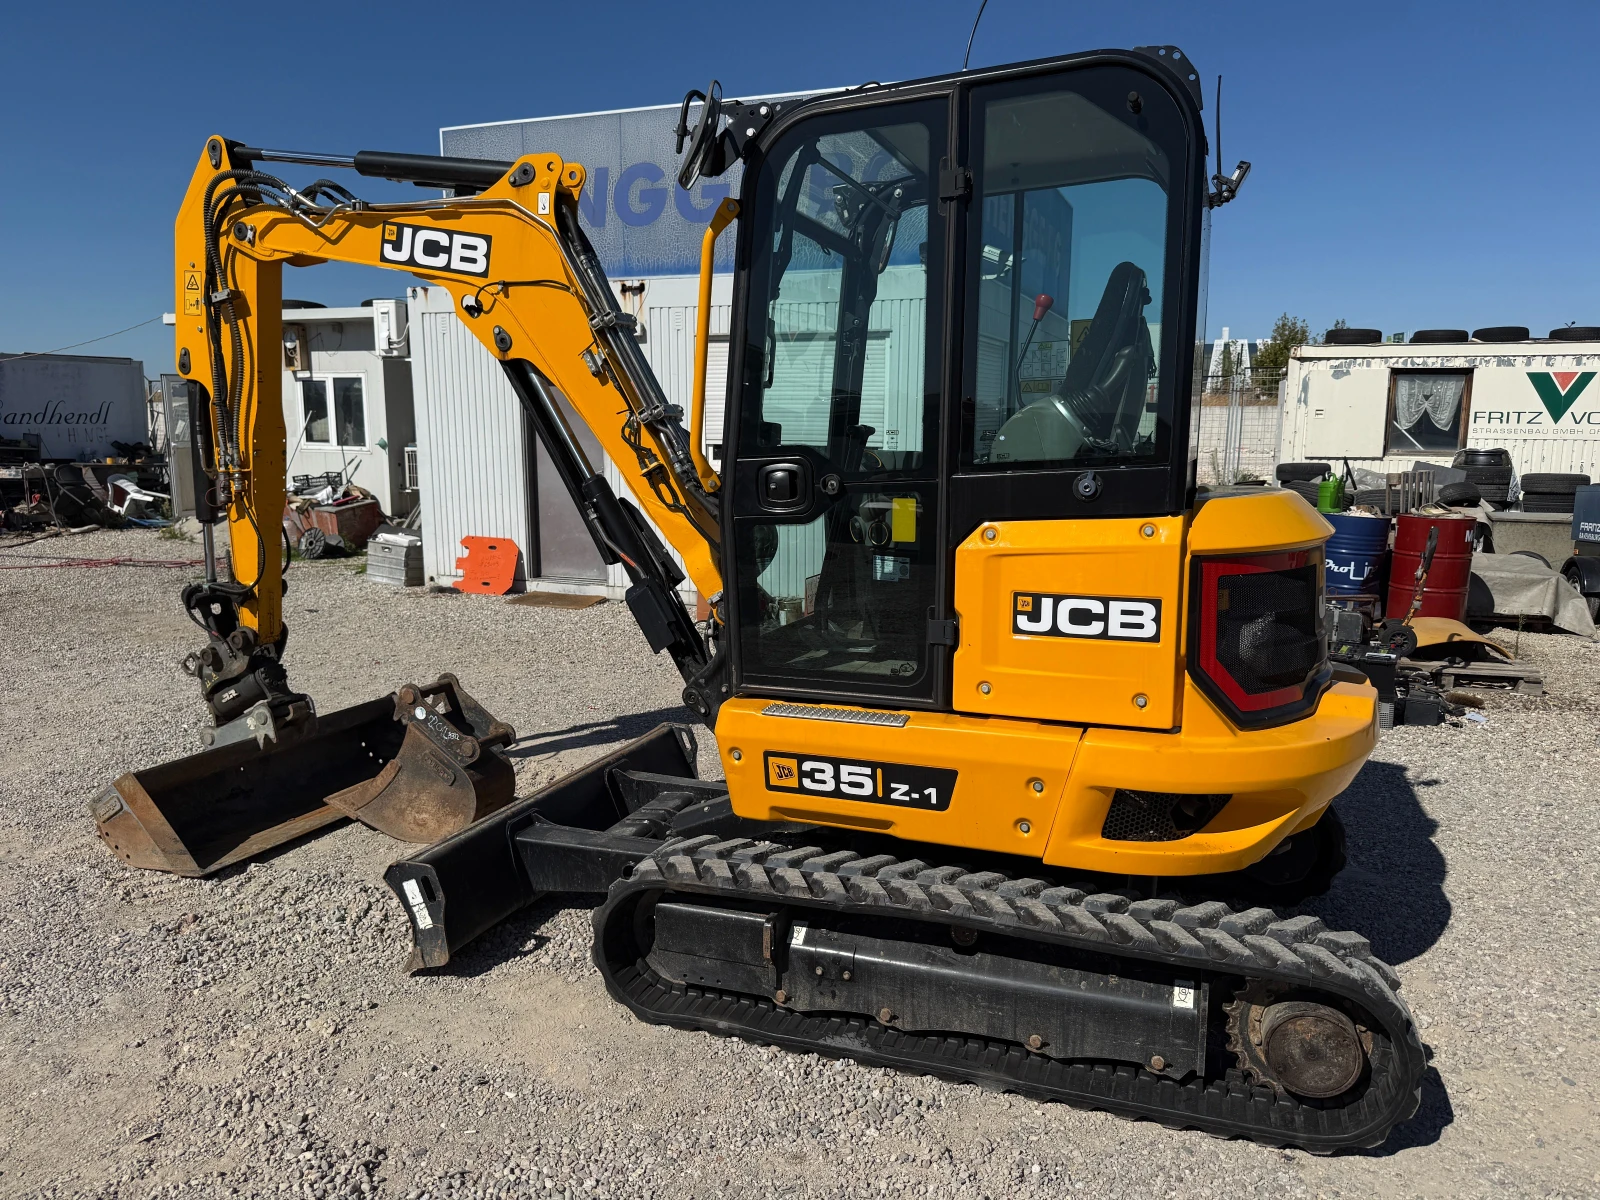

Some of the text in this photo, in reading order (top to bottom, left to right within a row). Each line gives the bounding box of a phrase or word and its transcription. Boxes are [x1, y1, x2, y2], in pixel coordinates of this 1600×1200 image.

[383, 226, 488, 274] JCB
[0, 399, 114, 425] andhendl
[1473, 411, 1544, 424] FRITZ
[1472, 427, 1549, 435] STRASSENBAU
[1016, 597, 1157, 638] JCB
[775, 760, 938, 805] JCB 35 Z-1
